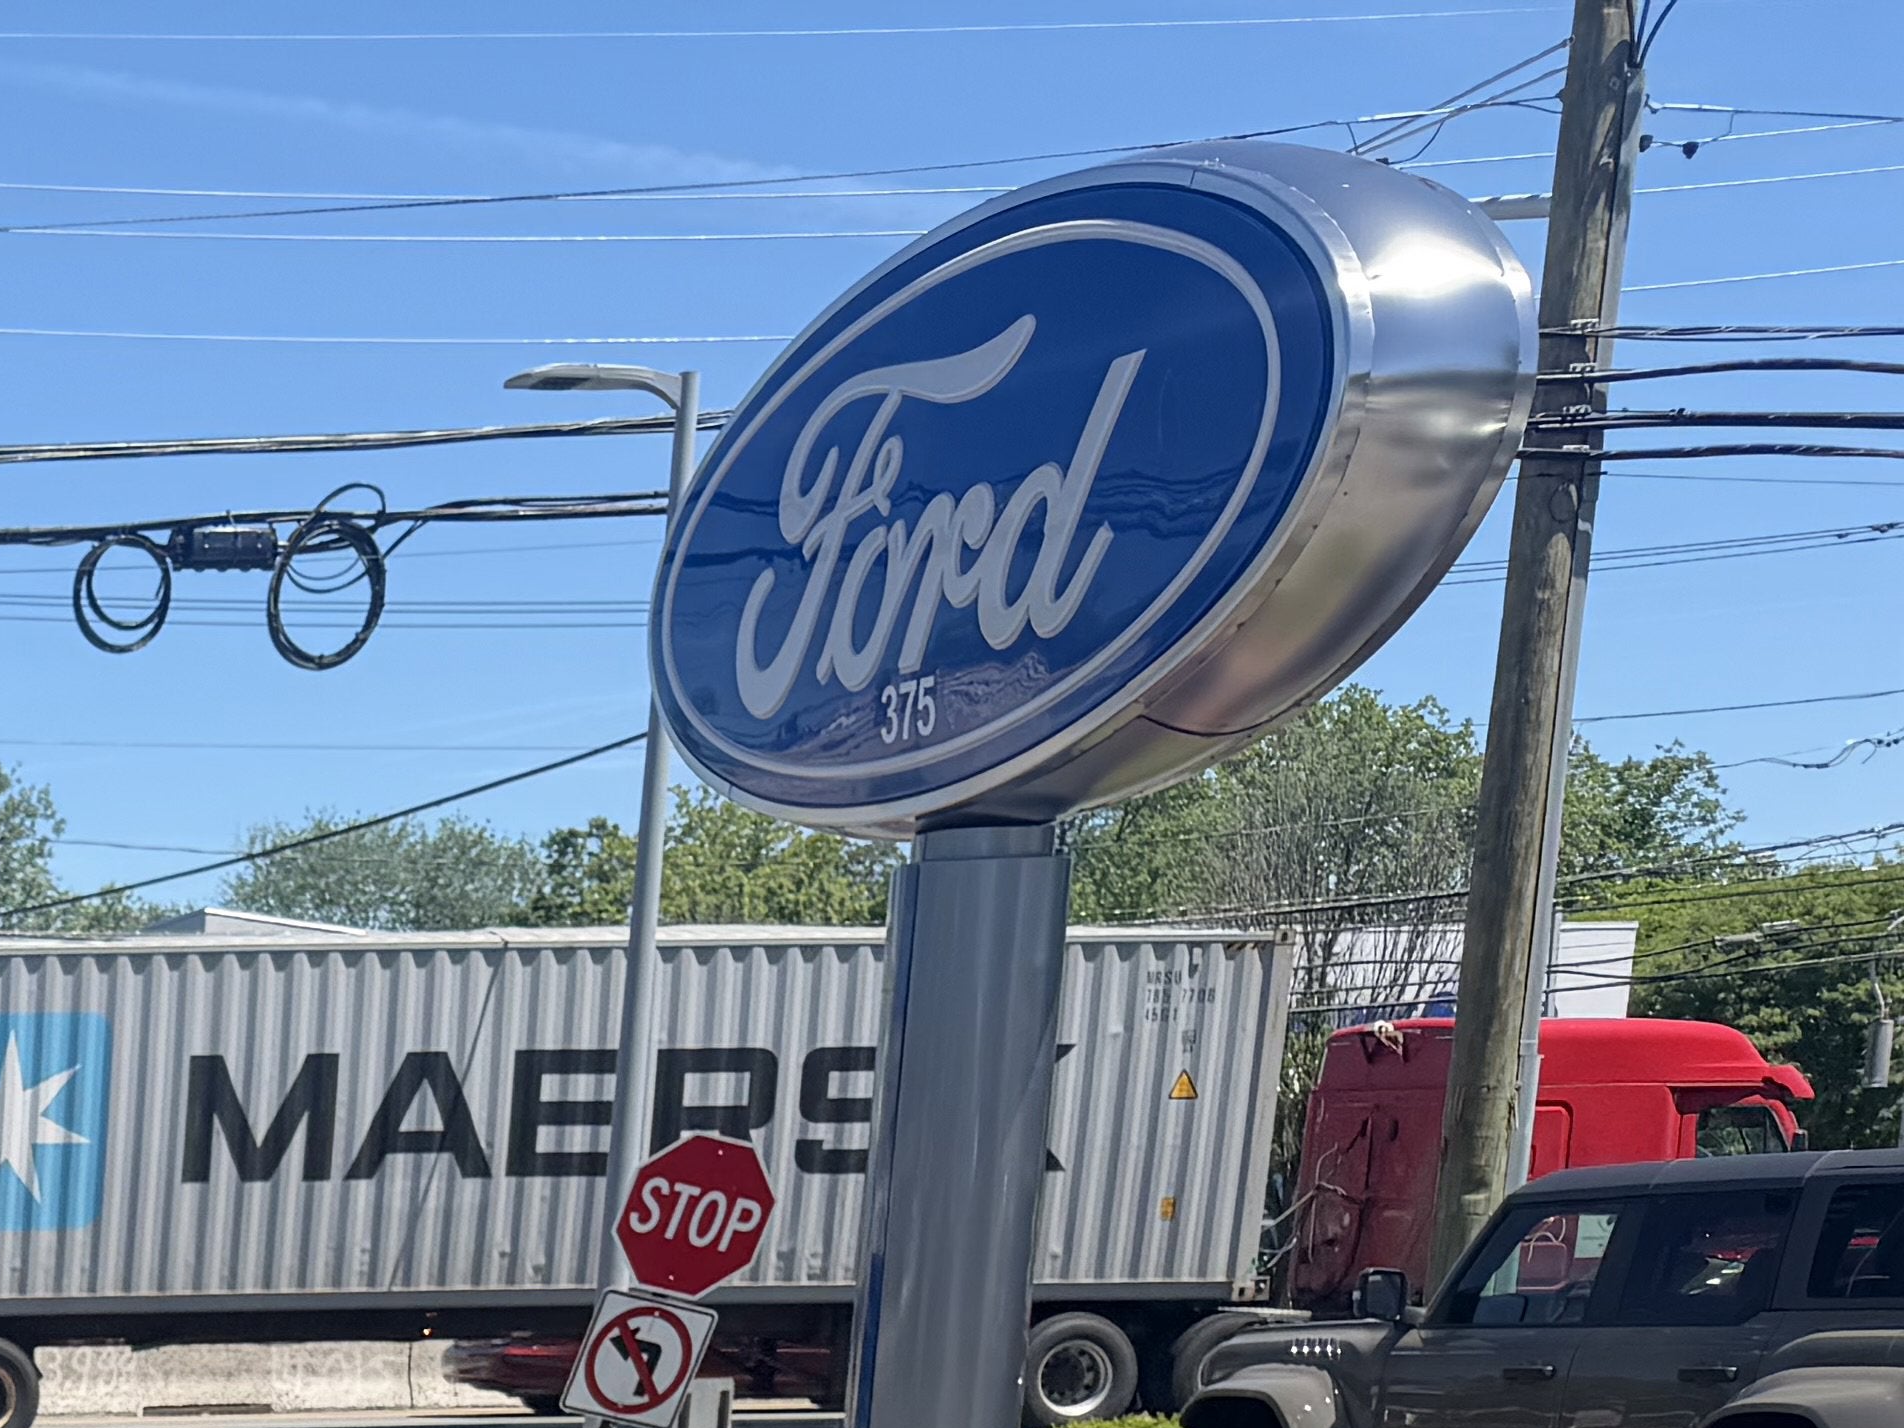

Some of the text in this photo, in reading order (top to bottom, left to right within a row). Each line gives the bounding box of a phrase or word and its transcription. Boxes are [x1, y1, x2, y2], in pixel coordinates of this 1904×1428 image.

[736, 314, 1148, 720] Ford
[880, 675, 936, 744] 375
[181, 1043, 1077, 1185] MAERS
[629, 1176, 762, 1253] STOP
